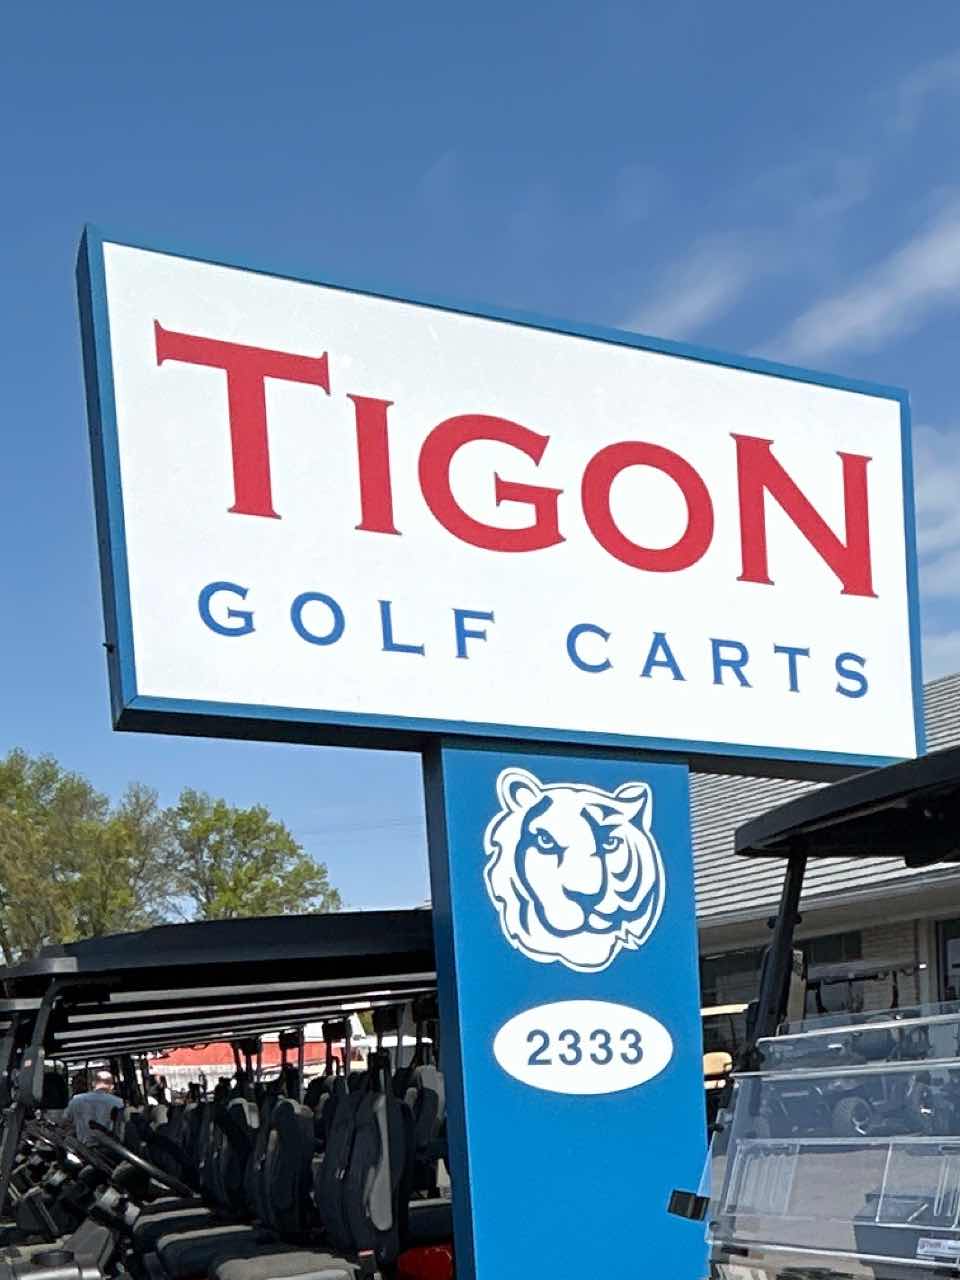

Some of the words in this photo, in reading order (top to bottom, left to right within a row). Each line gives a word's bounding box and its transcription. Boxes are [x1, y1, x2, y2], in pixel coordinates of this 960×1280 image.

[154, 319, 879, 598] TIGON
[198, 581, 495, 659] GOLF
[566, 623, 870, 699] CARTS
[526, 1029, 644, 1066] 2333
